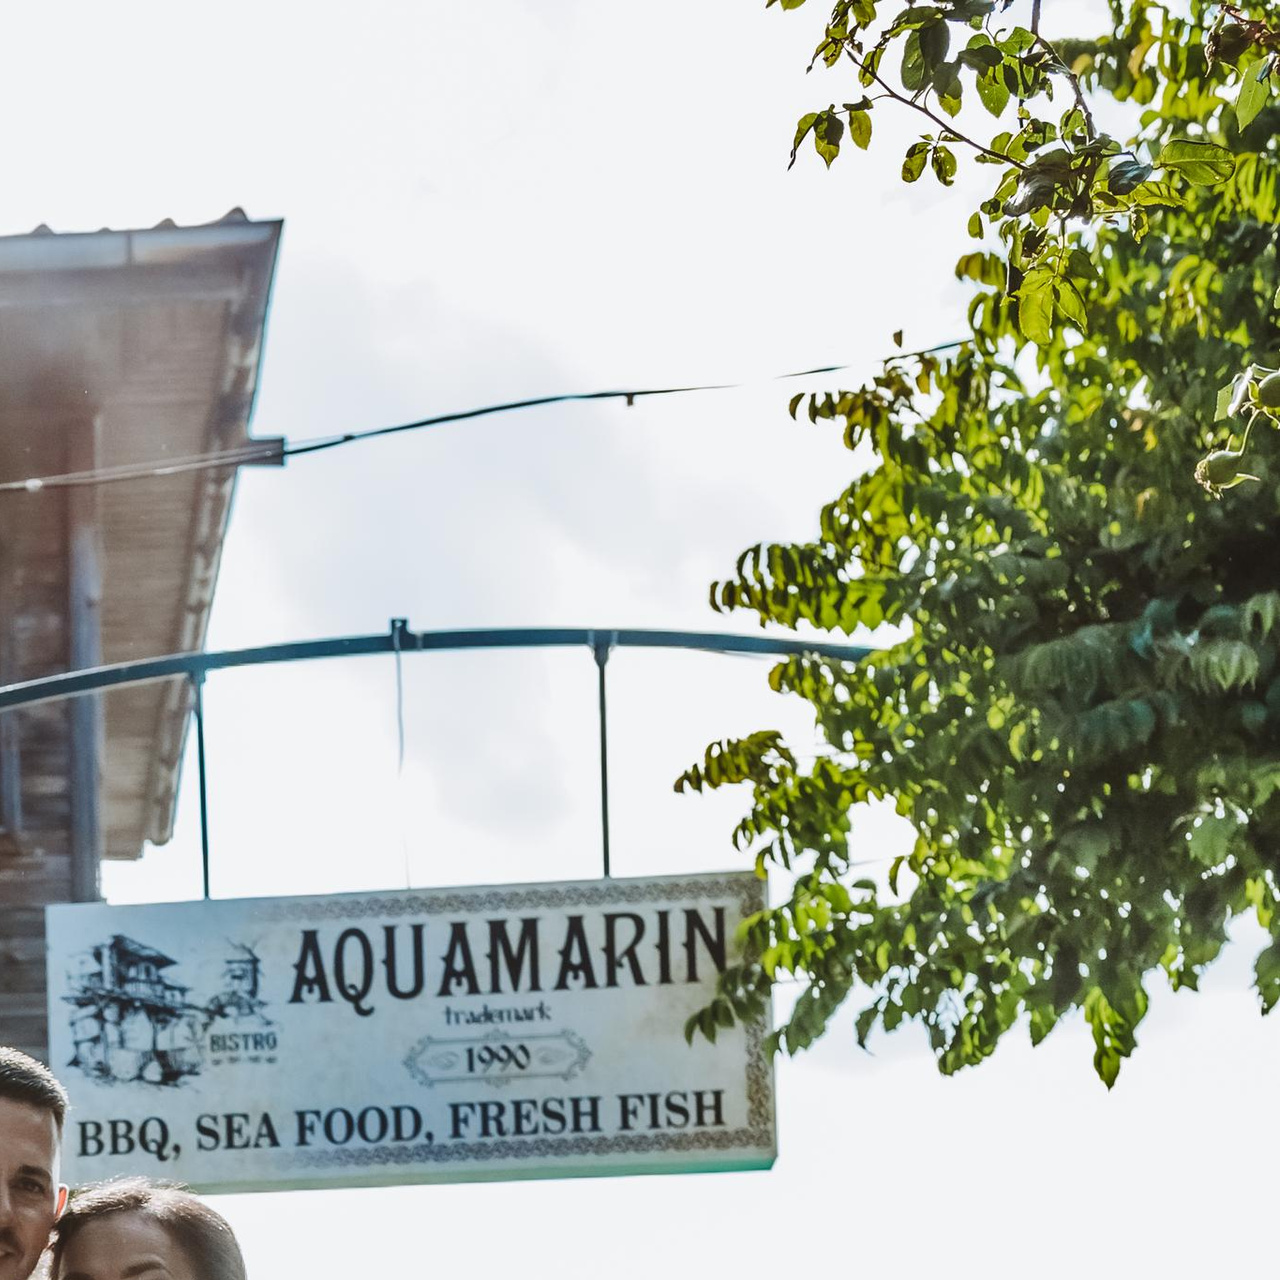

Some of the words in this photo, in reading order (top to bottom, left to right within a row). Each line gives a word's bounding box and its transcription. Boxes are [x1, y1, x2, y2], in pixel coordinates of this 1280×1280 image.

[288, 907, 727, 1017] AQUAMARIN
[210, 1031, 278, 1053] BISTRO
[466, 1044, 531, 1073] 1990
[77, 1120, 182, 1160] BBQ,
[196, 1113, 280, 1152] SEA
[294, 1105, 437, 1147] FOOD,
[448, 1096, 603, 1140] FRESH
[616, 1089, 728, 1132] FISH
